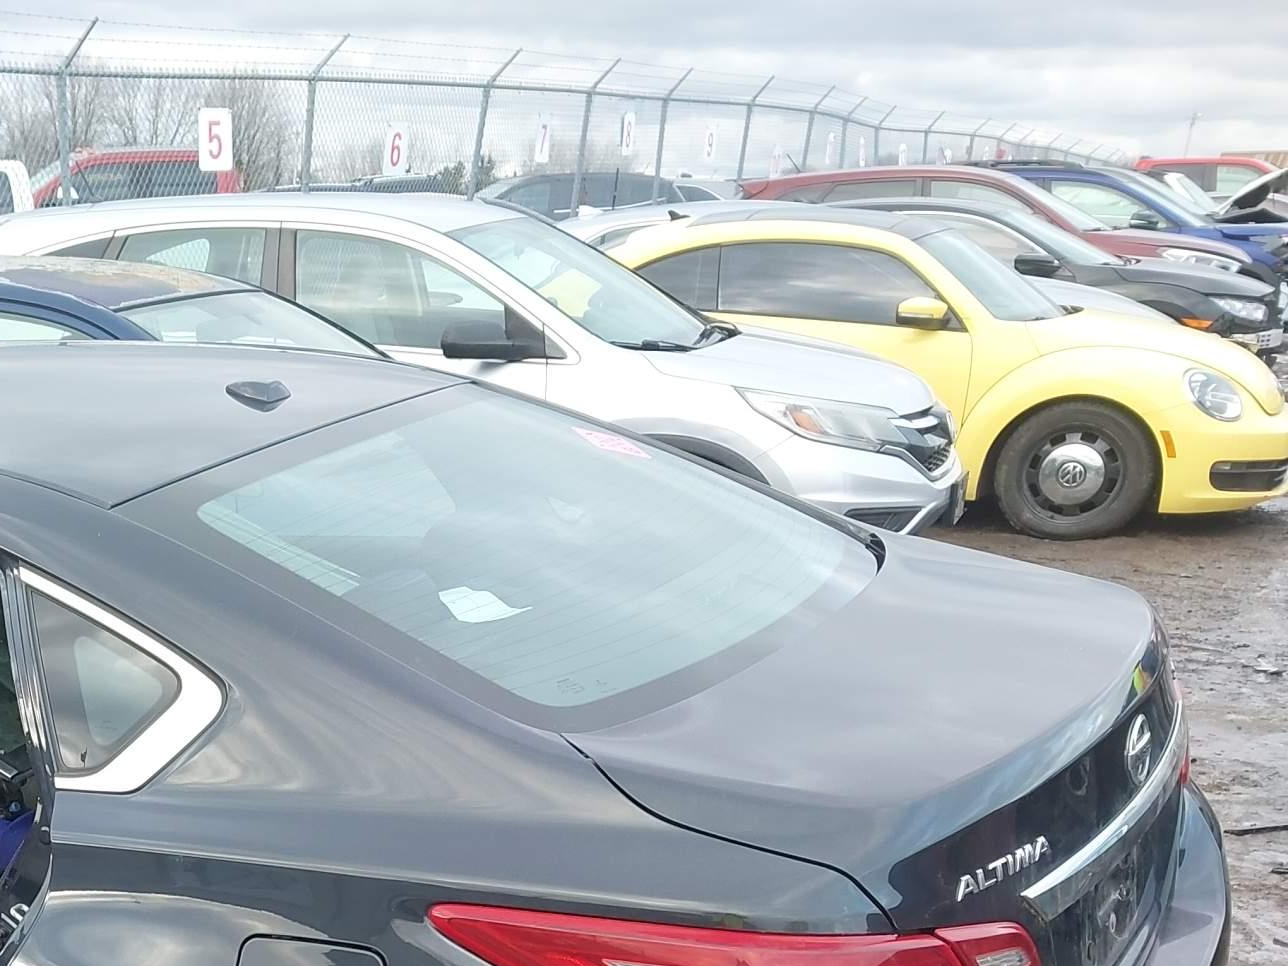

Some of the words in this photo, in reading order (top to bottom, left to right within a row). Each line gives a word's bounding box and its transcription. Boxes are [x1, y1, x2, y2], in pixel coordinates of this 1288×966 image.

[207, 119, 223, 160] 5
[389, 131, 403, 167] 6
[539, 123, 548, 154] 7
[625, 120, 632, 149] 8
[955, 834, 1050, 903] ALTIMA
